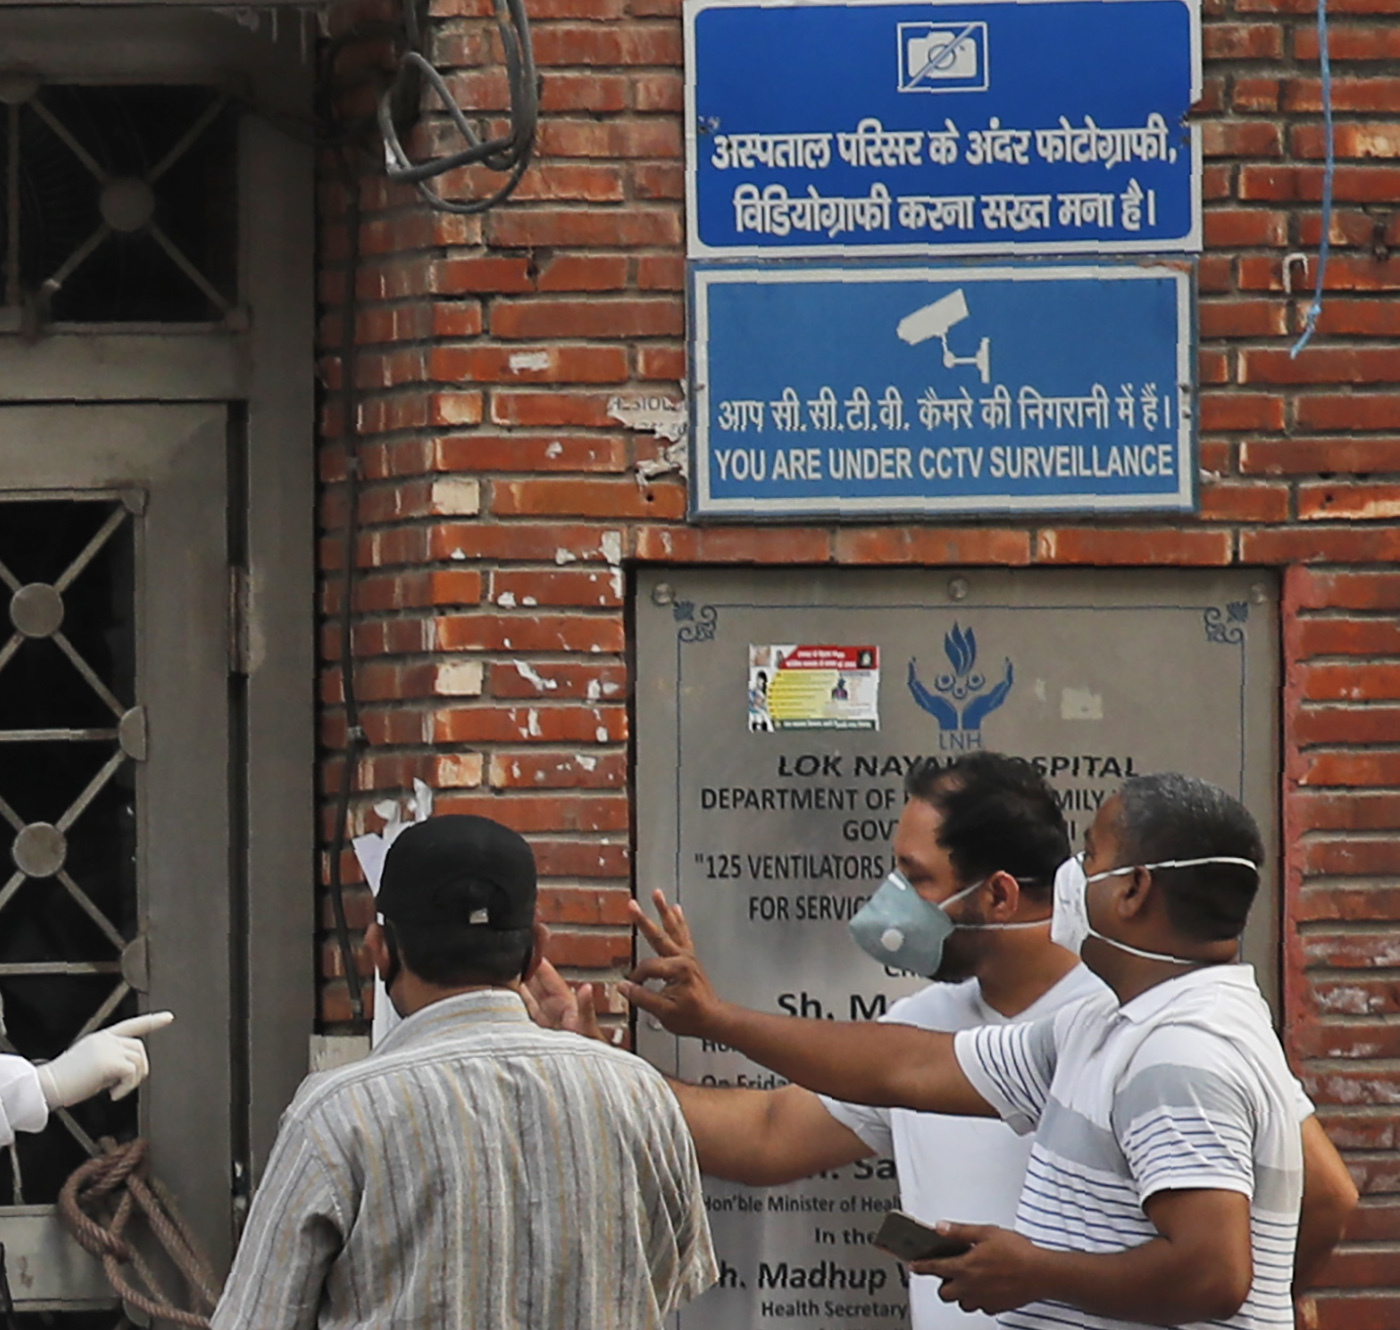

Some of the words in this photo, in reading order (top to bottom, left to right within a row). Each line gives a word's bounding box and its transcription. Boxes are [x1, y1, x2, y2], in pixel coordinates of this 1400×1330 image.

[711, 133, 833, 169] अस्पताल
[835, 117, 925, 167] परिसर
[927, 118, 960, 165] के
[966, 116, 1031, 165] अंदर
[1034, 112, 1177, 170] फोटोग्राफी,
[732, 182, 892, 239] विडियोग्राफी
[897, 194, 975, 232] करना
[980, 194, 1052, 231] सख्त
[1056, 193, 1114, 228] मना
[717, 400, 764, 432] आप
[916, 386, 974, 430] कैमरे
[978, 383, 1011, 430] की
[1016, 382, 1110, 430] निगरानी
[1114, 382, 1135, 429] में
[714, 448, 767, 481] YOU
[771, 448, 823, 480] ARE
[828, 447, 914, 480] UNDER
[919, 447, 984, 479] CCTV
[989, 444, 1174, 479] SURVEILLANCE
[939, 733, 981, 750] LNH
[778, 755, 842, 777] LOK
[1031, 755, 1139, 778] SPITAL
[701, 788, 858, 811] DEPARTMENT
[866, 788, 896, 810] OF
[694, 855, 741, 878] "125
[748, 855, 884, 879] VENTILATORS
[749, 897, 790, 920] FOR
[796, 896, 872, 920] SERVIC
[768, 1194, 833, 1213] Minister
[840, 1196, 856, 1213] of
[815, 1227, 835, 1244] In
[720, 1260, 746, 1289] h.
[758, 1260, 887, 1295] Madhup
[762, 1301, 819, 1317] Health
[825, 1301, 908, 1319] Secretary
